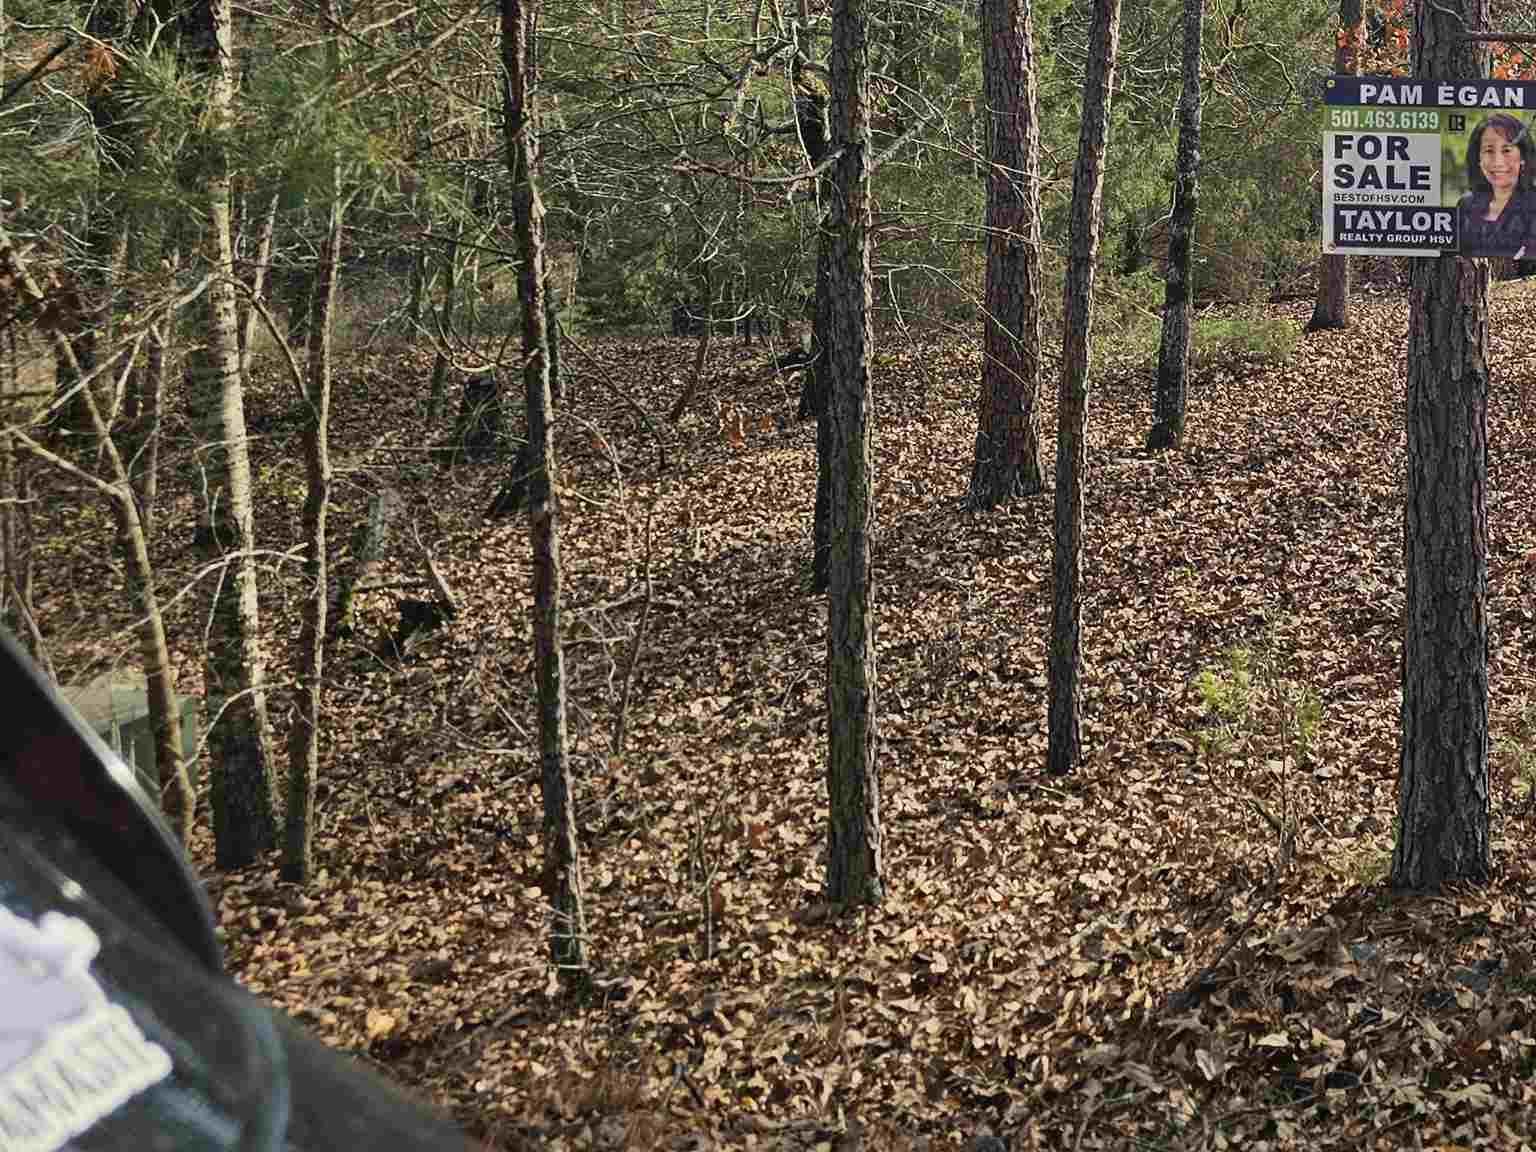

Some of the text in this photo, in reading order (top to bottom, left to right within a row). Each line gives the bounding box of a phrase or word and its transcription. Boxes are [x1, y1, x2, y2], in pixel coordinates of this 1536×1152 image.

[1359, 84, 1525, 108] PAM EGAN
[1330, 110, 1440, 129] 501.463.6139
[1333, 134, 1411, 161] FOR
[1333, 164, 1431, 191] SALE
[1333, 192, 1425, 204] BESTOFHSV.COM
[1339, 209, 1453, 232] TAYLOR
[1339, 232, 1454, 244] REALTY GROUP HSV
